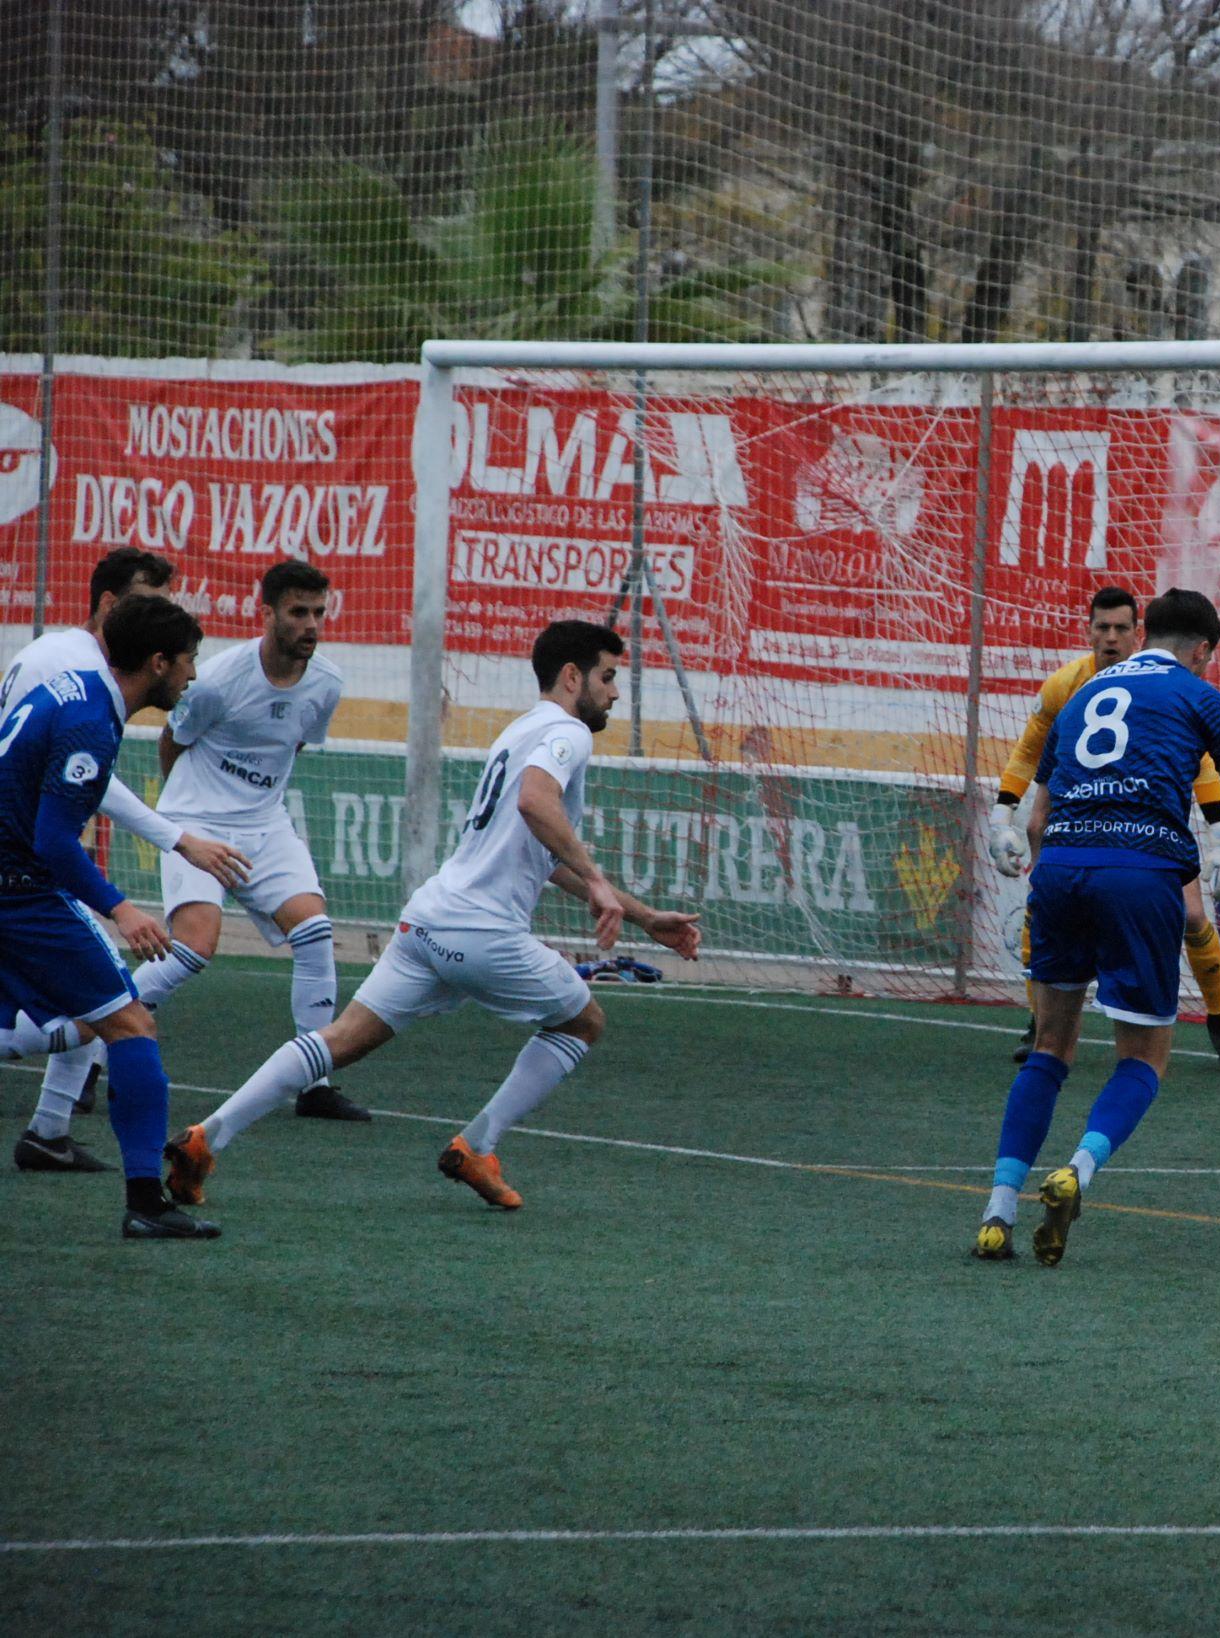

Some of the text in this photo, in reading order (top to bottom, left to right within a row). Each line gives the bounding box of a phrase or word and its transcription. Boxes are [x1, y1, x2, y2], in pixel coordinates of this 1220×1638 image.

[125, 404, 337, 463] MOSTACHONES
[73, 474, 389, 560] DIEGO VAZQUEZ
[461, 537, 687, 593] TRANSPORES
[1075, 687, 1132, 768] 8
[619, 806, 876, 911] UTRERA
[1074, 820, 1155, 836] DEPORTIVO
[1159, 826, 1184, 844] F.C.
